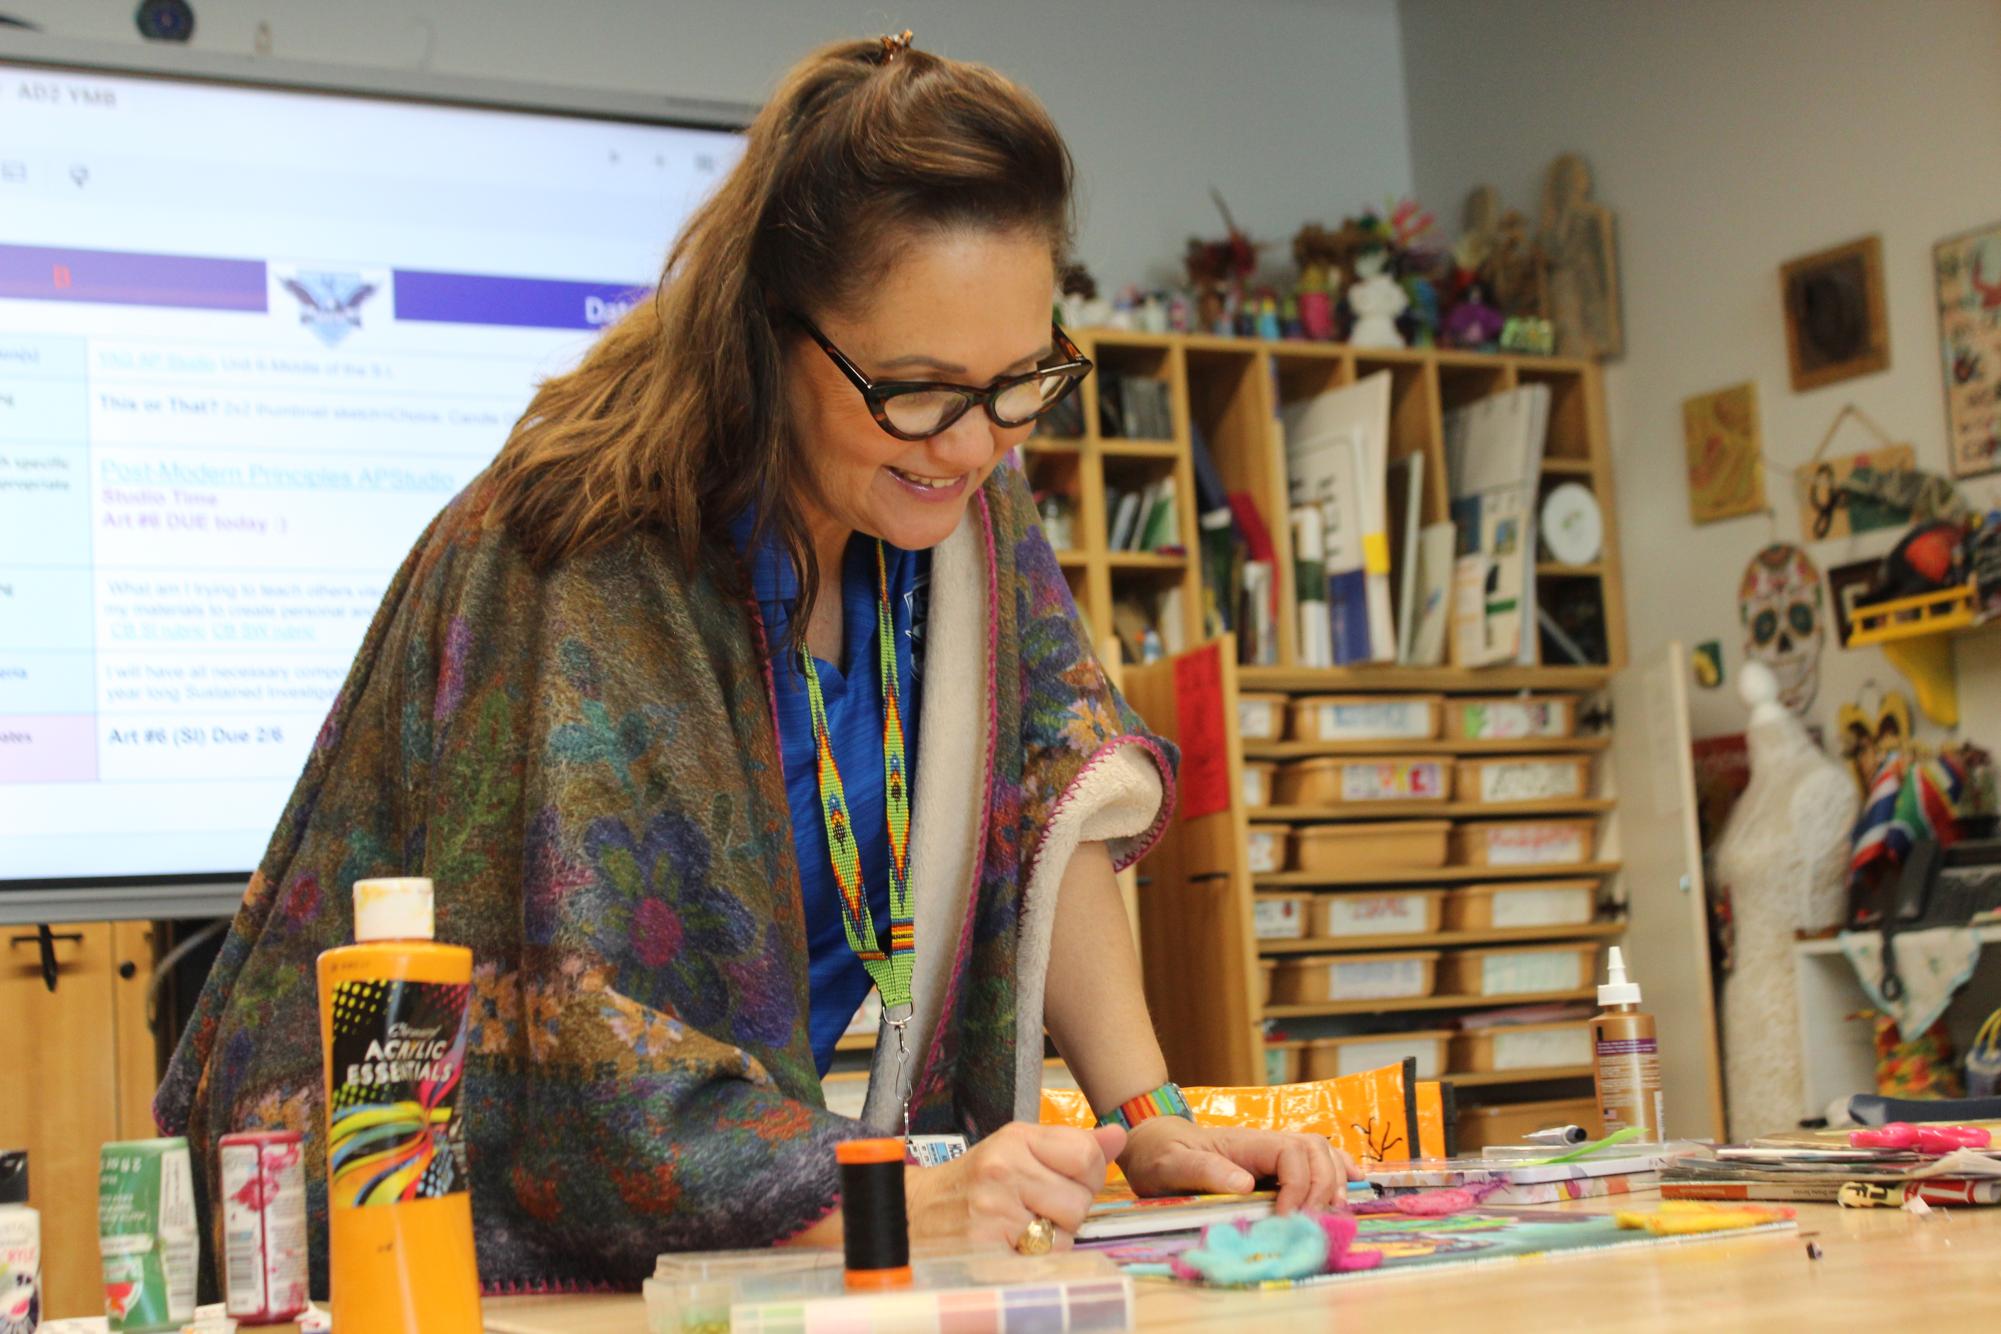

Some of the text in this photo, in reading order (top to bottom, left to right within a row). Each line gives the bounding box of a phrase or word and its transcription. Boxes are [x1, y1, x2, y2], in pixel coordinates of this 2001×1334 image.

[172, 488, 219, 506] Time
[103, 511, 132, 529] Art
[166, 511, 208, 531] DUE
[214, 514, 268, 536] today
[106, 579, 150, 596] What
[193, 581, 238, 600] trying
[145, 665, 184, 680] have
[145, 686, 181, 704] long
[184, 685, 264, 700] Sustained
[107, 727, 140, 744] Art
[211, 727, 250, 744] Due
[346, 1060, 453, 1086] ESSENTIALS
